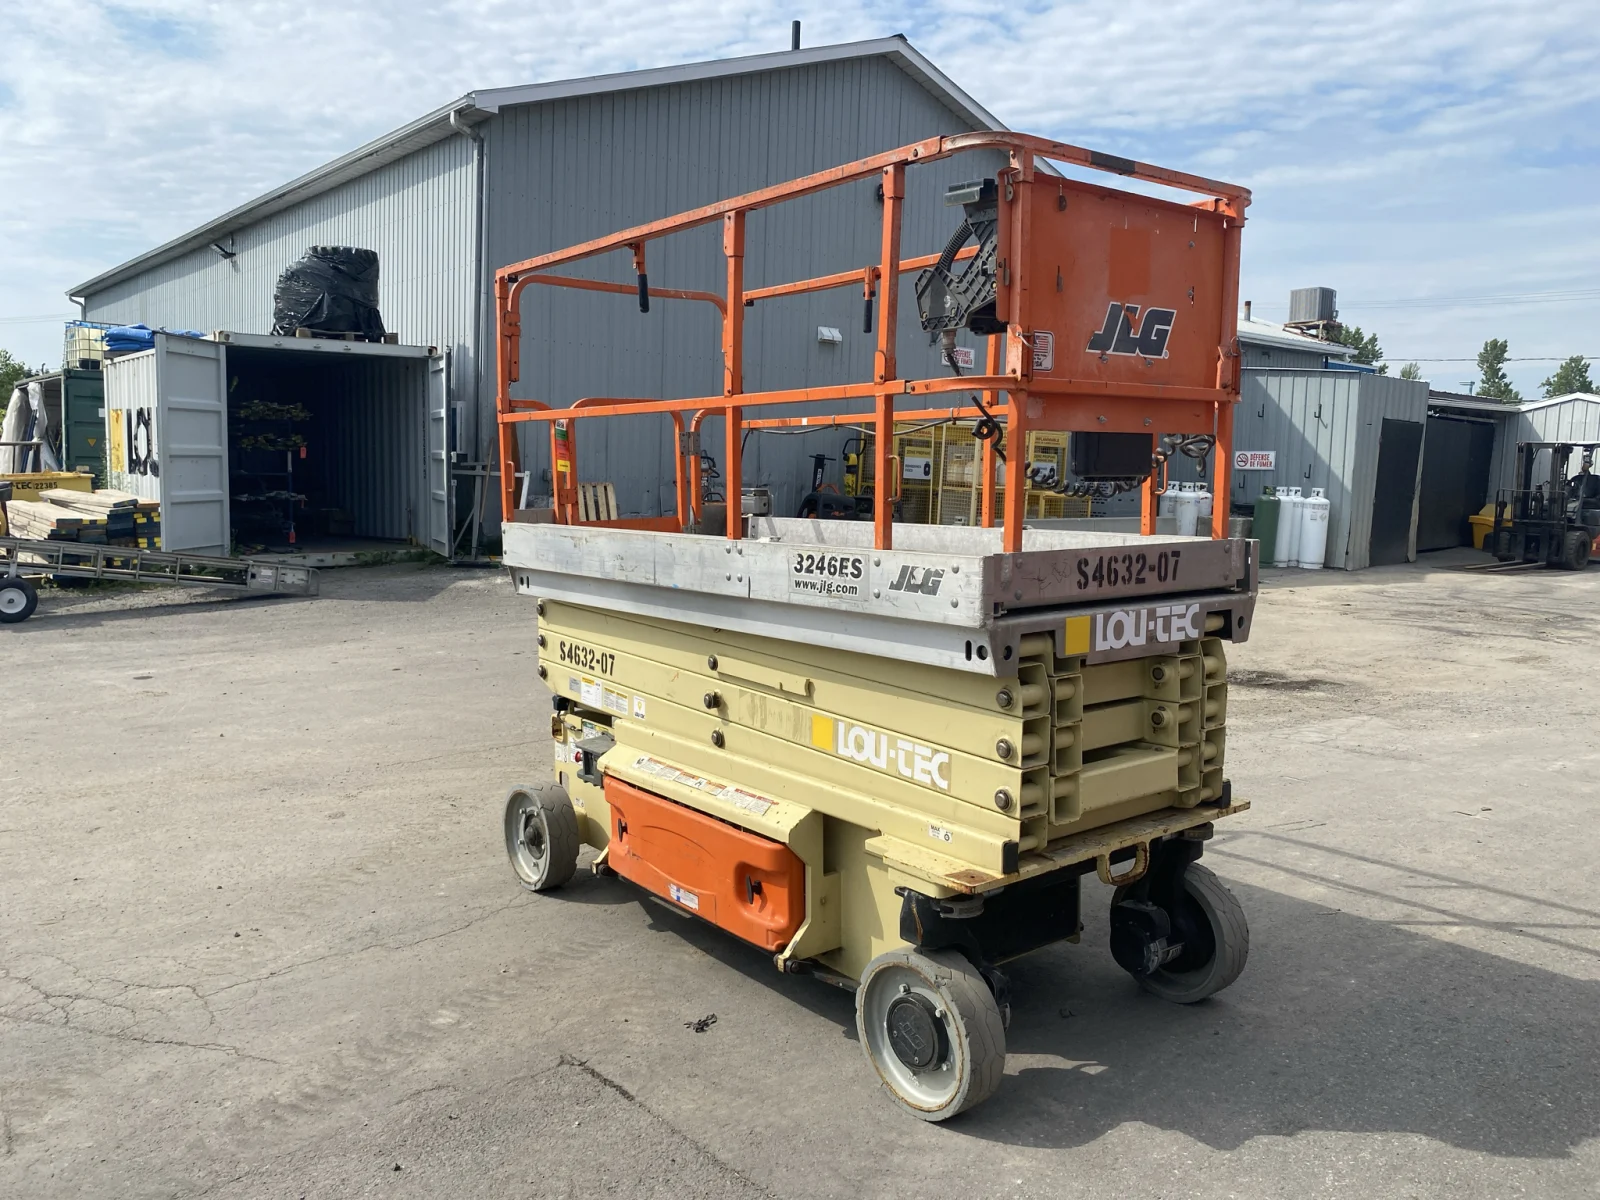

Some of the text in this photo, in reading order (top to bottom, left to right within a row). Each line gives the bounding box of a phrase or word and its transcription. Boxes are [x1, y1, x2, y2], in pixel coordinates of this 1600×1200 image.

[1085, 301, 1177, 359] JLG
[35, 481, 58, 490] 22385
[794, 553, 863, 579] 3246ES
[888, 564, 945, 596] JLG
[1076, 550, 1181, 590] S4632-07
[794, 579, 858, 596] www.jlg.com
[1095, 603, 1200, 652] LOU-TEC
[560, 640, 615, 677] S4632-07
[837, 721, 949, 790] LOU-TEC
